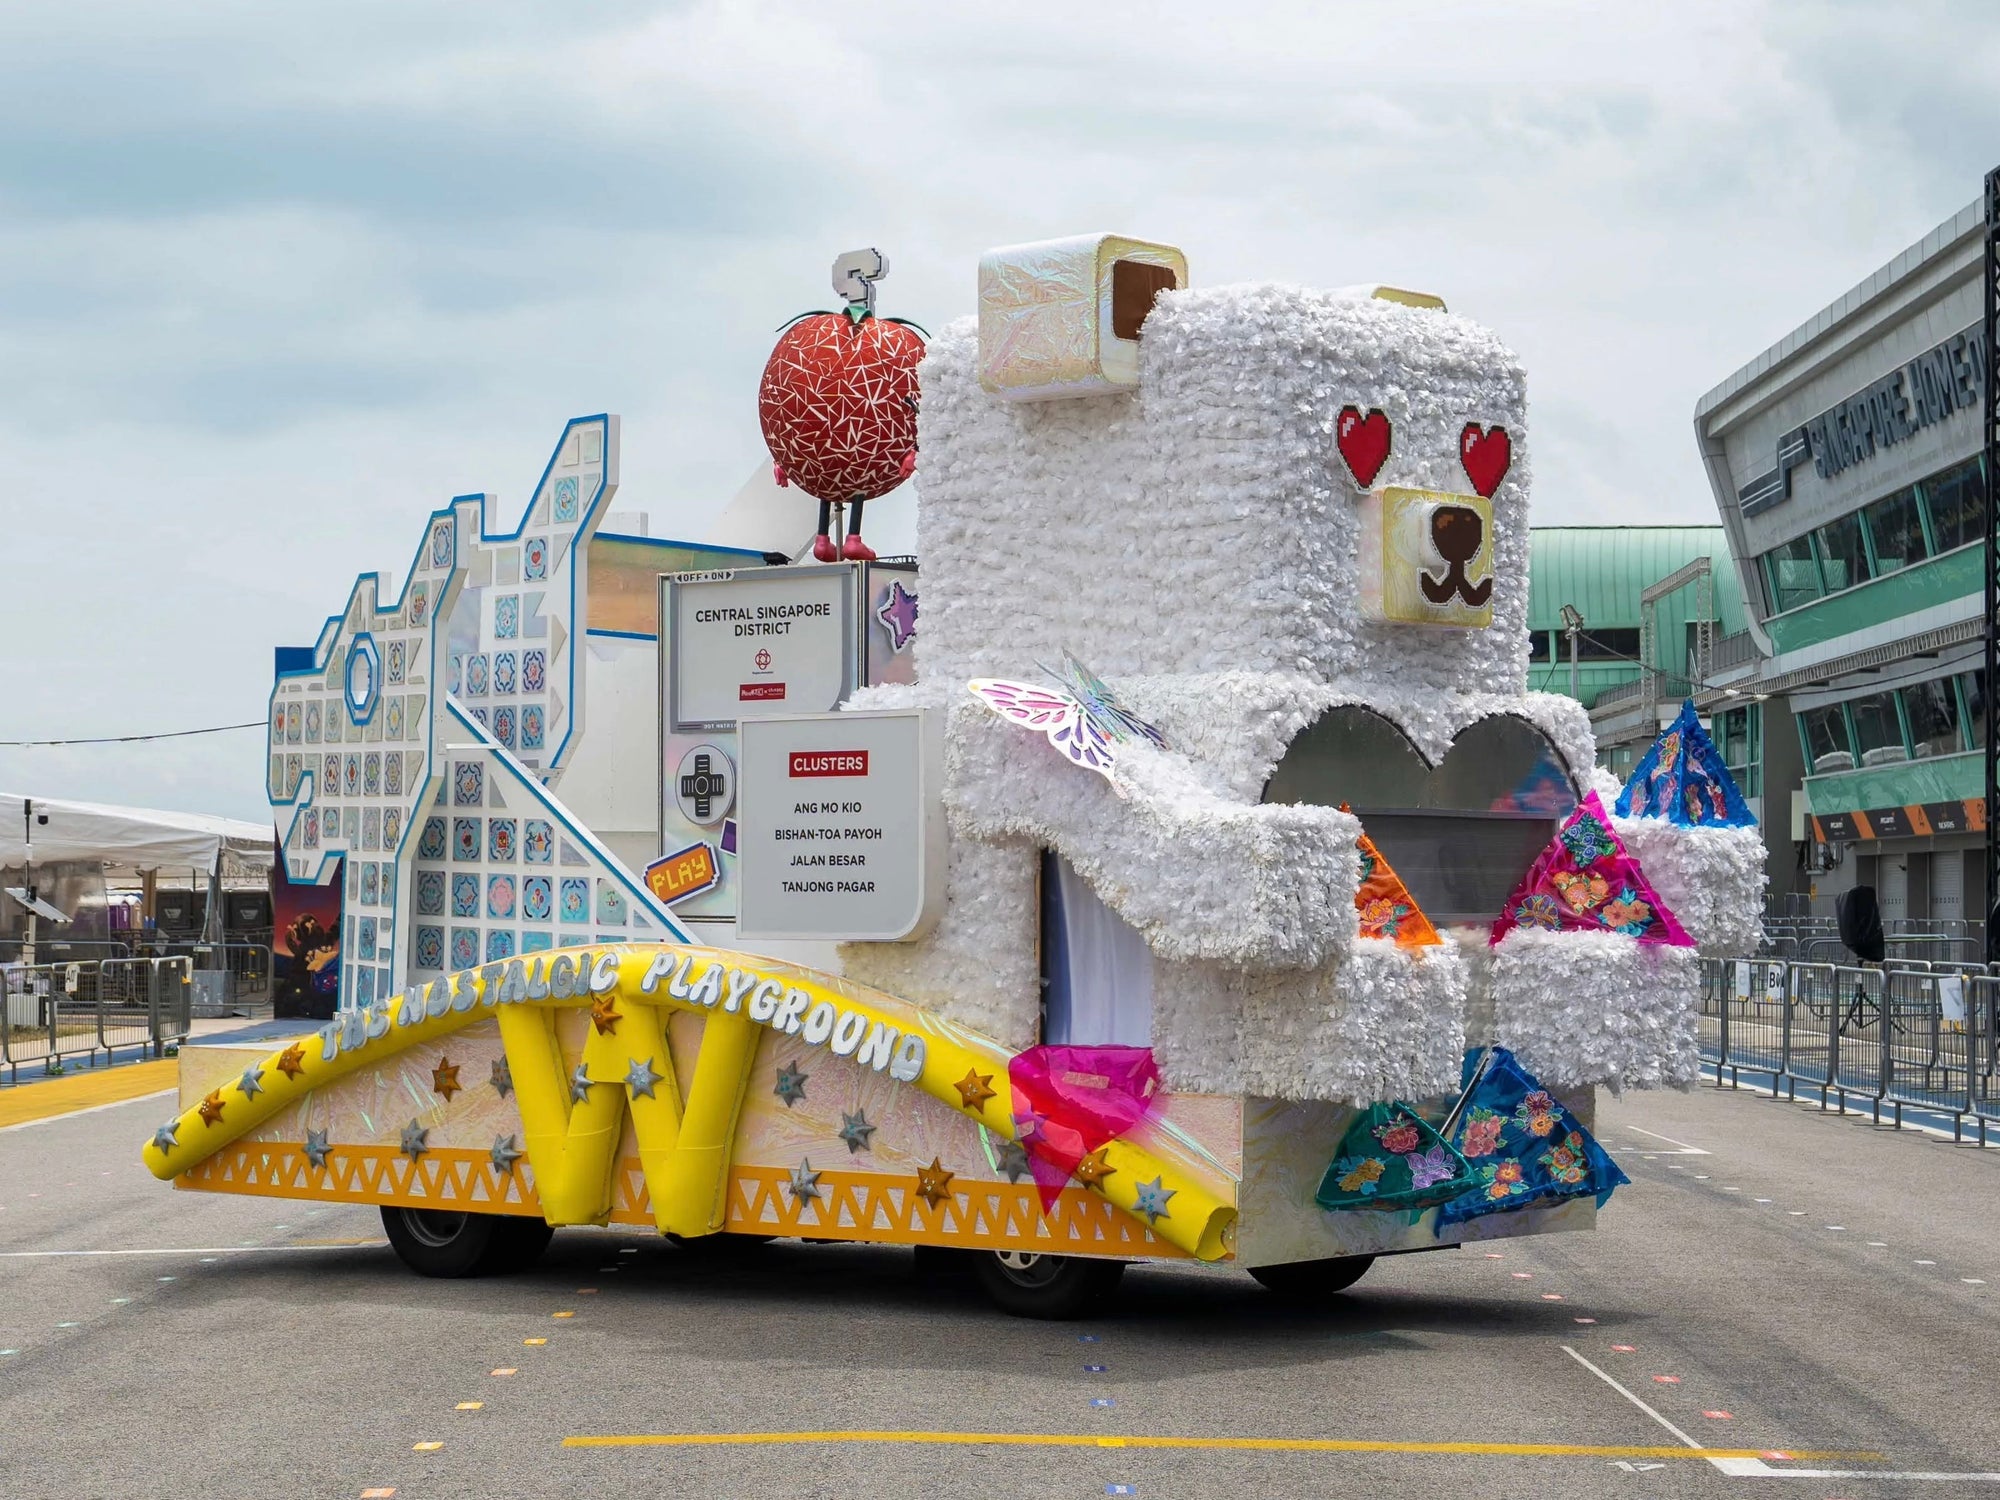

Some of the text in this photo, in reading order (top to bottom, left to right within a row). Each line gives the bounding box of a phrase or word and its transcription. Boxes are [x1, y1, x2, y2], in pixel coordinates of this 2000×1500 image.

[1907, 334, 1978, 427] HOME
[683, 572, 724, 582] OFF ON
[695, 603, 831, 623] CENTRAL SINGAPORE
[734, 622, 791, 637] DISTRICT
[793, 756, 864, 772] CLUSTERS
[794, 801, 862, 814] ANG MO KIO
[775, 828, 882, 841] BISHAN-TOA PAYOH
[790, 854, 866, 866] JALAN BESAR
[652, 854, 707, 896] PLAY
[782, 881, 875, 893] TANJONG PAGAR
[397, 951, 620, 1028] NOSTALGIC
[640, 952, 927, 1083] PLAYGROUND
